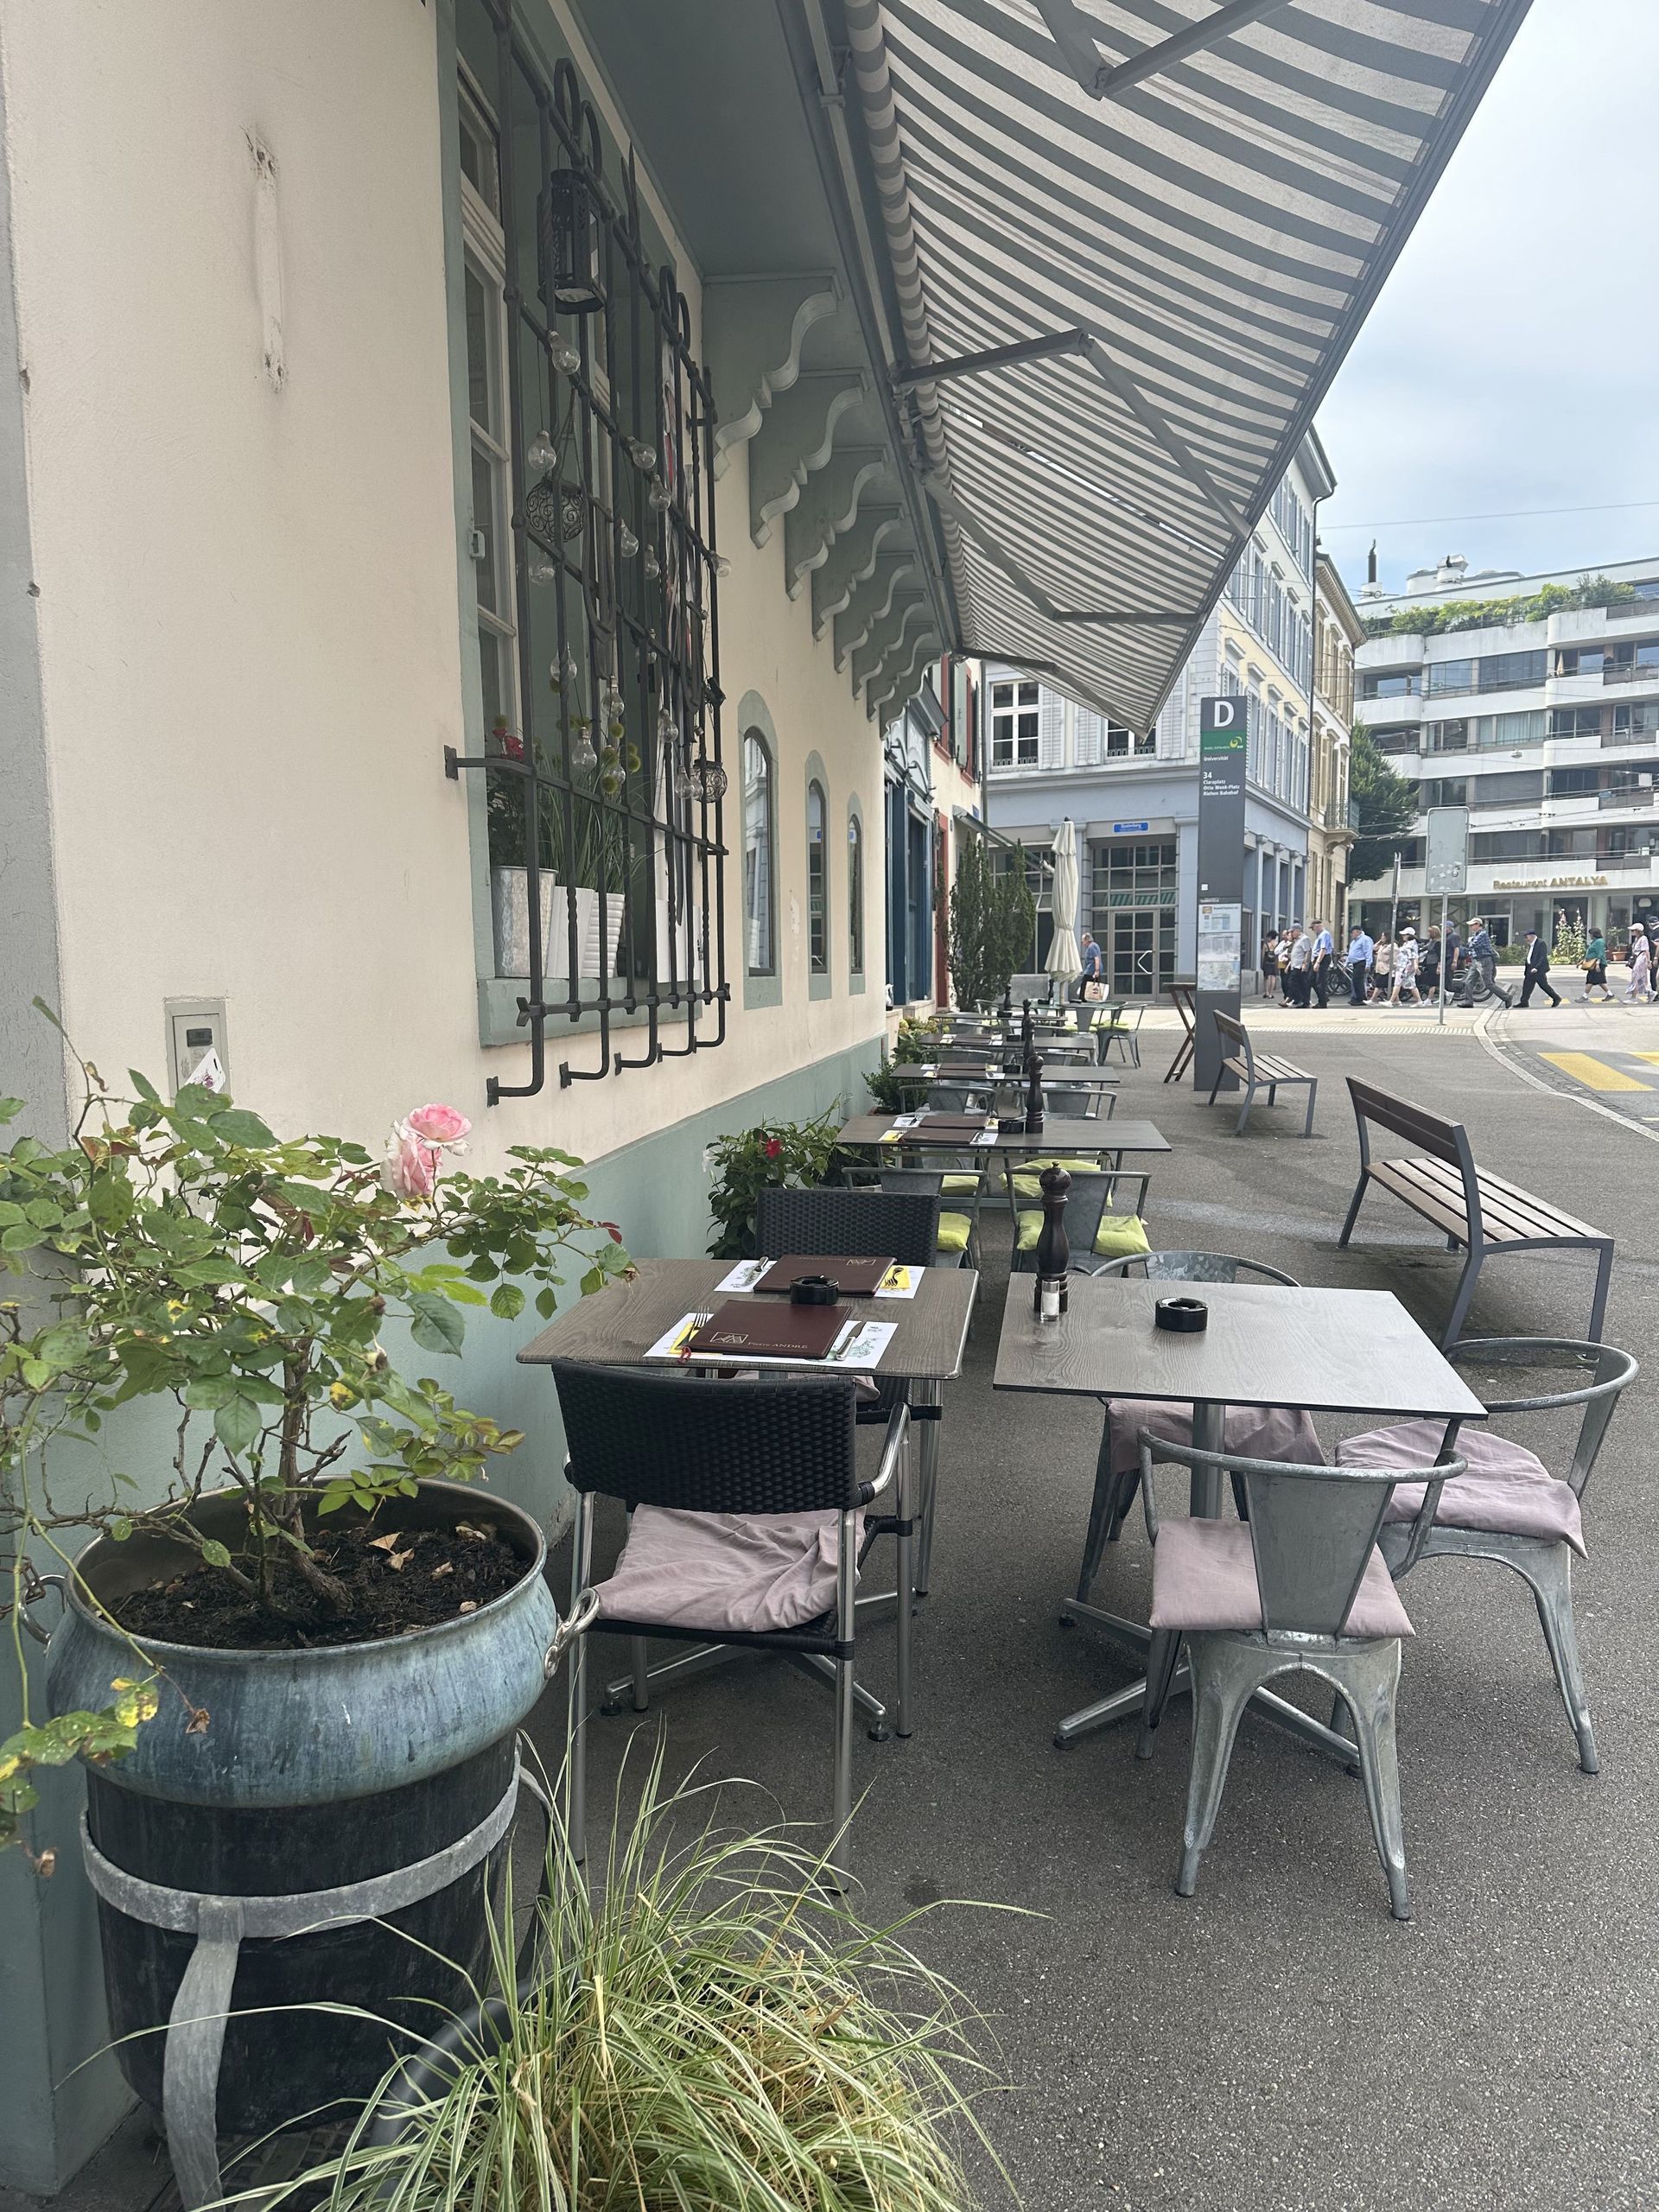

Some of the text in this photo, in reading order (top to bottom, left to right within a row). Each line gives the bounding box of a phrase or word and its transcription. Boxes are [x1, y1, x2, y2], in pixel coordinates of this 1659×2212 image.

[1214, 701, 1235, 728] D
[1493, 875, 1608, 889] Restaurant ANTALYA
